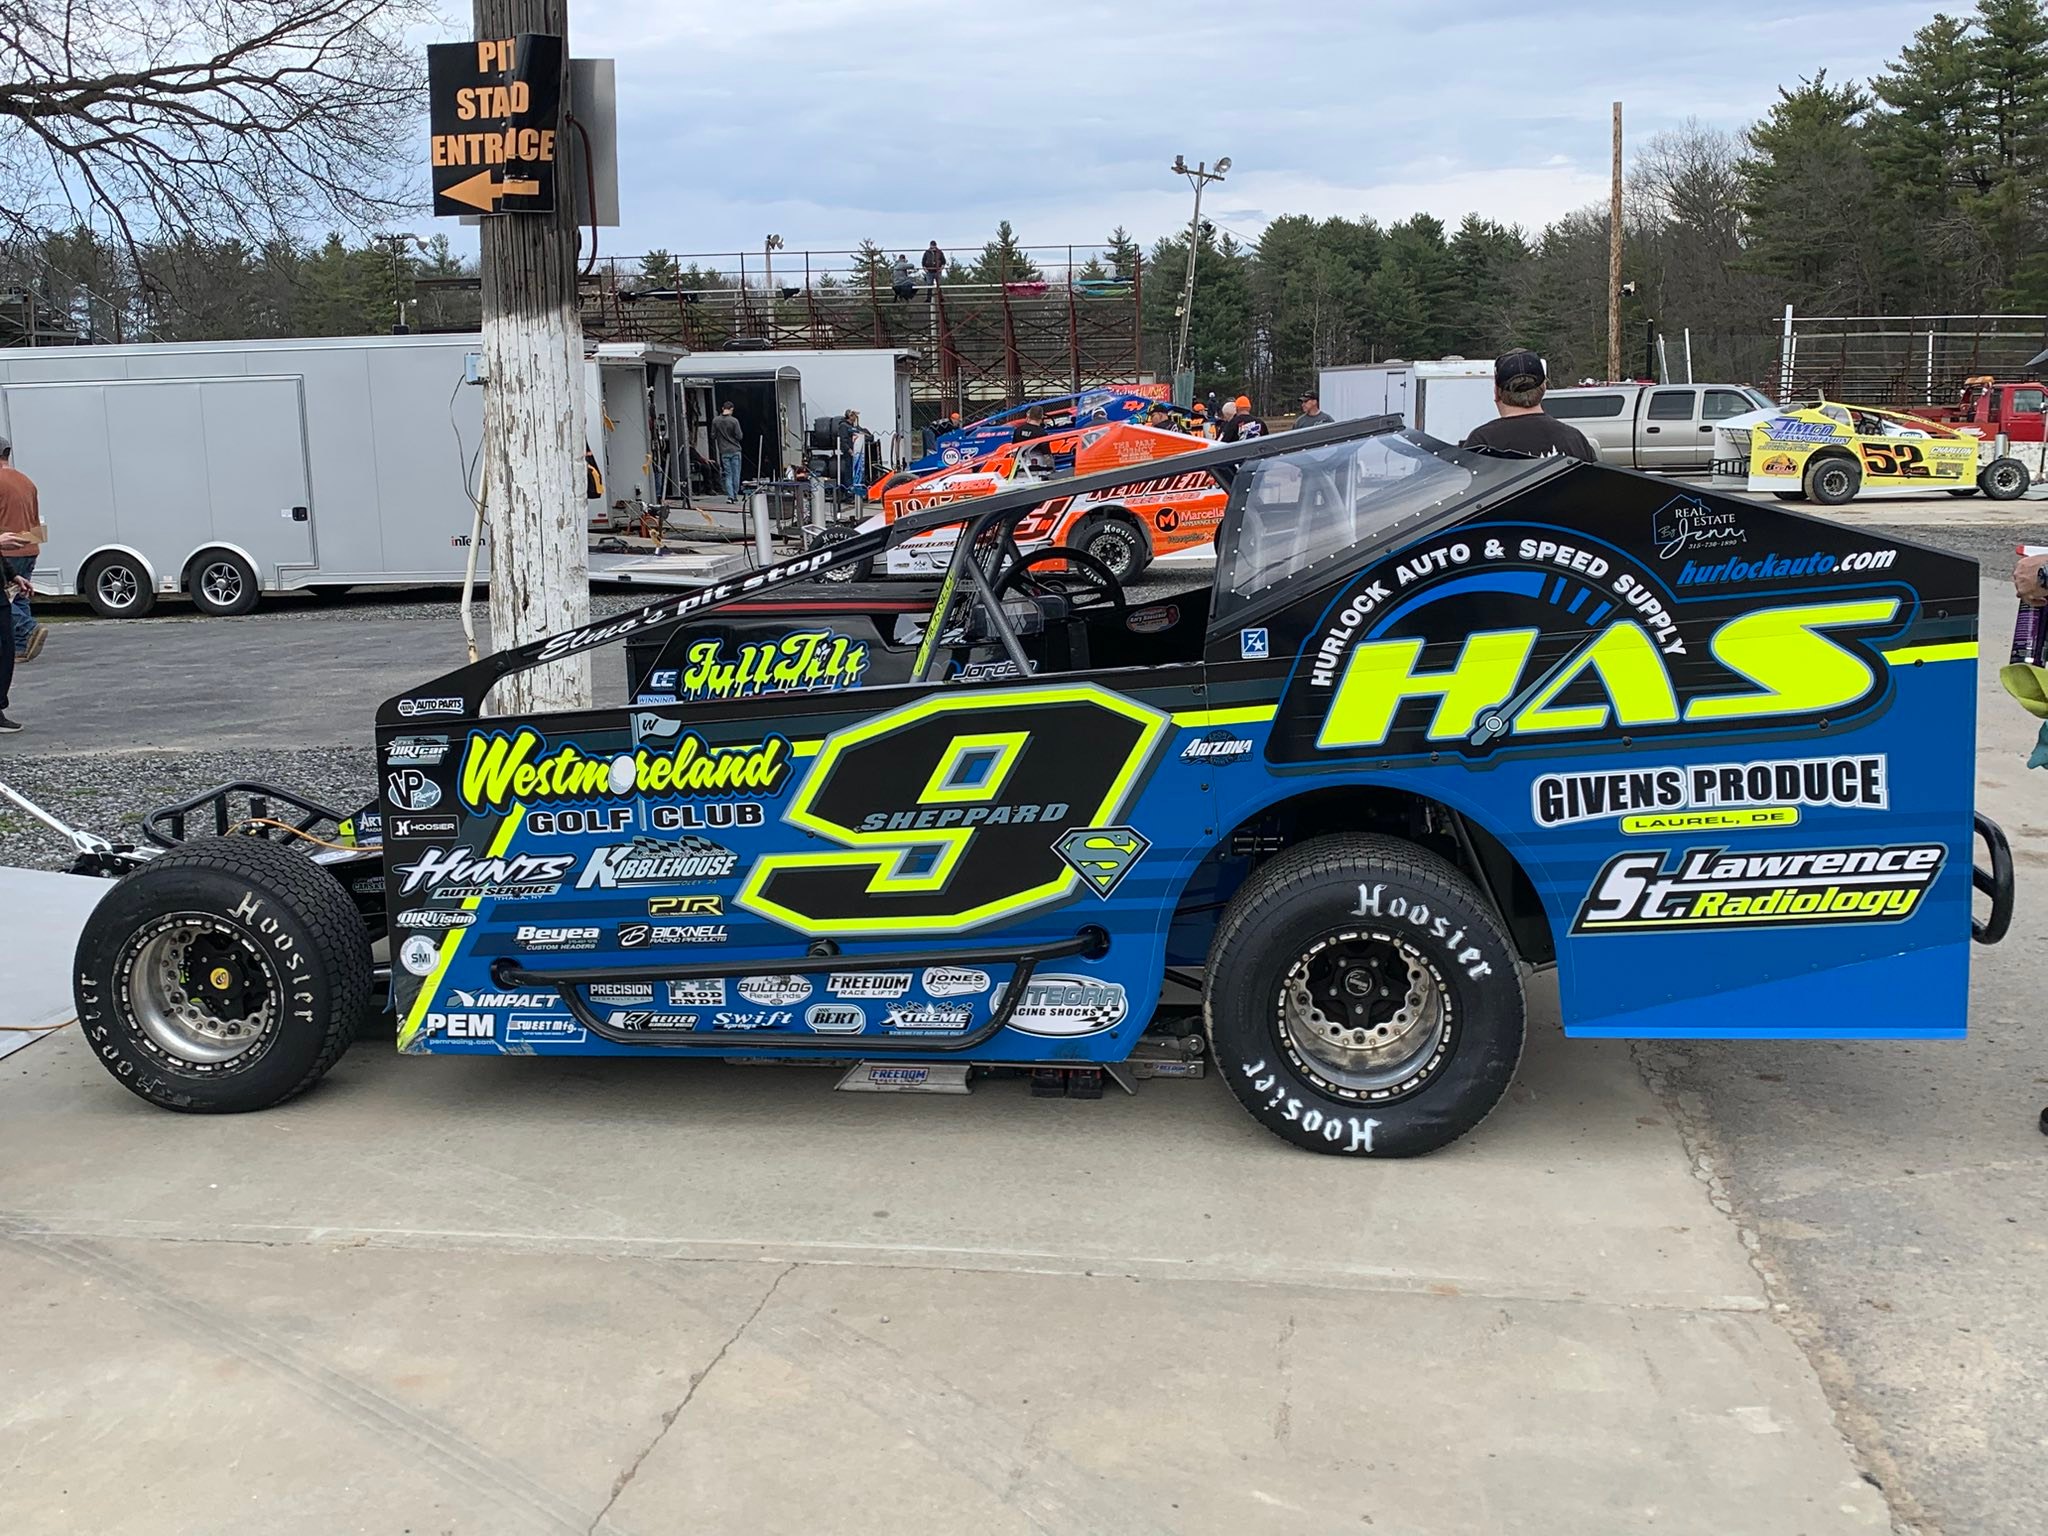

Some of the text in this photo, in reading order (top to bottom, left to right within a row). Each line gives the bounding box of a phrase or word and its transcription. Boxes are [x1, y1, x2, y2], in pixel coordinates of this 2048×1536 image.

[478, 38, 515, 73] PIT
[1858, 443, 1931, 476] 52
[1675, 507, 1706, 518] REAL
[1694, 513, 1736, 526] ESTATE
[1104, 524, 1136, 545] Hoosier
[1676, 550, 1897, 586] hurlockauto.com
[538, 551, 833, 661] Elmo's pit stop
[1311, 539, 1688, 687] HURLOCK AUTO & SPEED SUPPLY
[1315, 598, 1902, 751] HAS
[416, 700, 437, 710] AUTO
[438, 699, 462, 709] PARTS
[388, 770, 425, 810] VP
[1537, 759, 1883, 824] GIVENS PRODUCE
[733, 682, 1171, 936] 9
[861, 804, 1070, 831] SHEPPARD
[410, 823, 456, 832] HOOSIER
[527, 803, 764, 835] GOLF CLUB
[1635, 812, 1785, 829] LAUREL, DE
[438, 884, 556, 898] AUTO SERVICE
[1587, 848, 1943, 922] St. Lawrence
[650, 896, 724, 916] PTR
[1690, 887, 1921, 918] Radiology
[516, 926, 600, 944] Beyea
[650, 936, 681, 944] RACING
[651, 925, 728, 938] BICKNELL
[1351, 883, 1492, 980] Hoosier
[227, 891, 315, 1024] Hoosier
[411, 953, 431, 963] SMI
[738, 982, 812, 993] BULLDOG
[830, 976, 910, 989] FREEDOM
[926, 974, 985, 985] JONES
[590, 984, 652, 995] PRECISION
[477, 994, 560, 1008] IMPACT
[650, 1015, 697, 1023] KEIZER
[813, 1012, 859, 1024] BERT
[880, 1010, 970, 1025] XTREME
[1049, 1008, 1097, 1016] SHOCKS
[426, 1013, 495, 1037] PEM
[517, 1020, 552, 1031] SWEET
[429, 1038, 496, 1046] pemracing.com
[871, 1069, 927, 1079] FREEDOM
[1242, 1060, 1384, 1153] Hoosier
